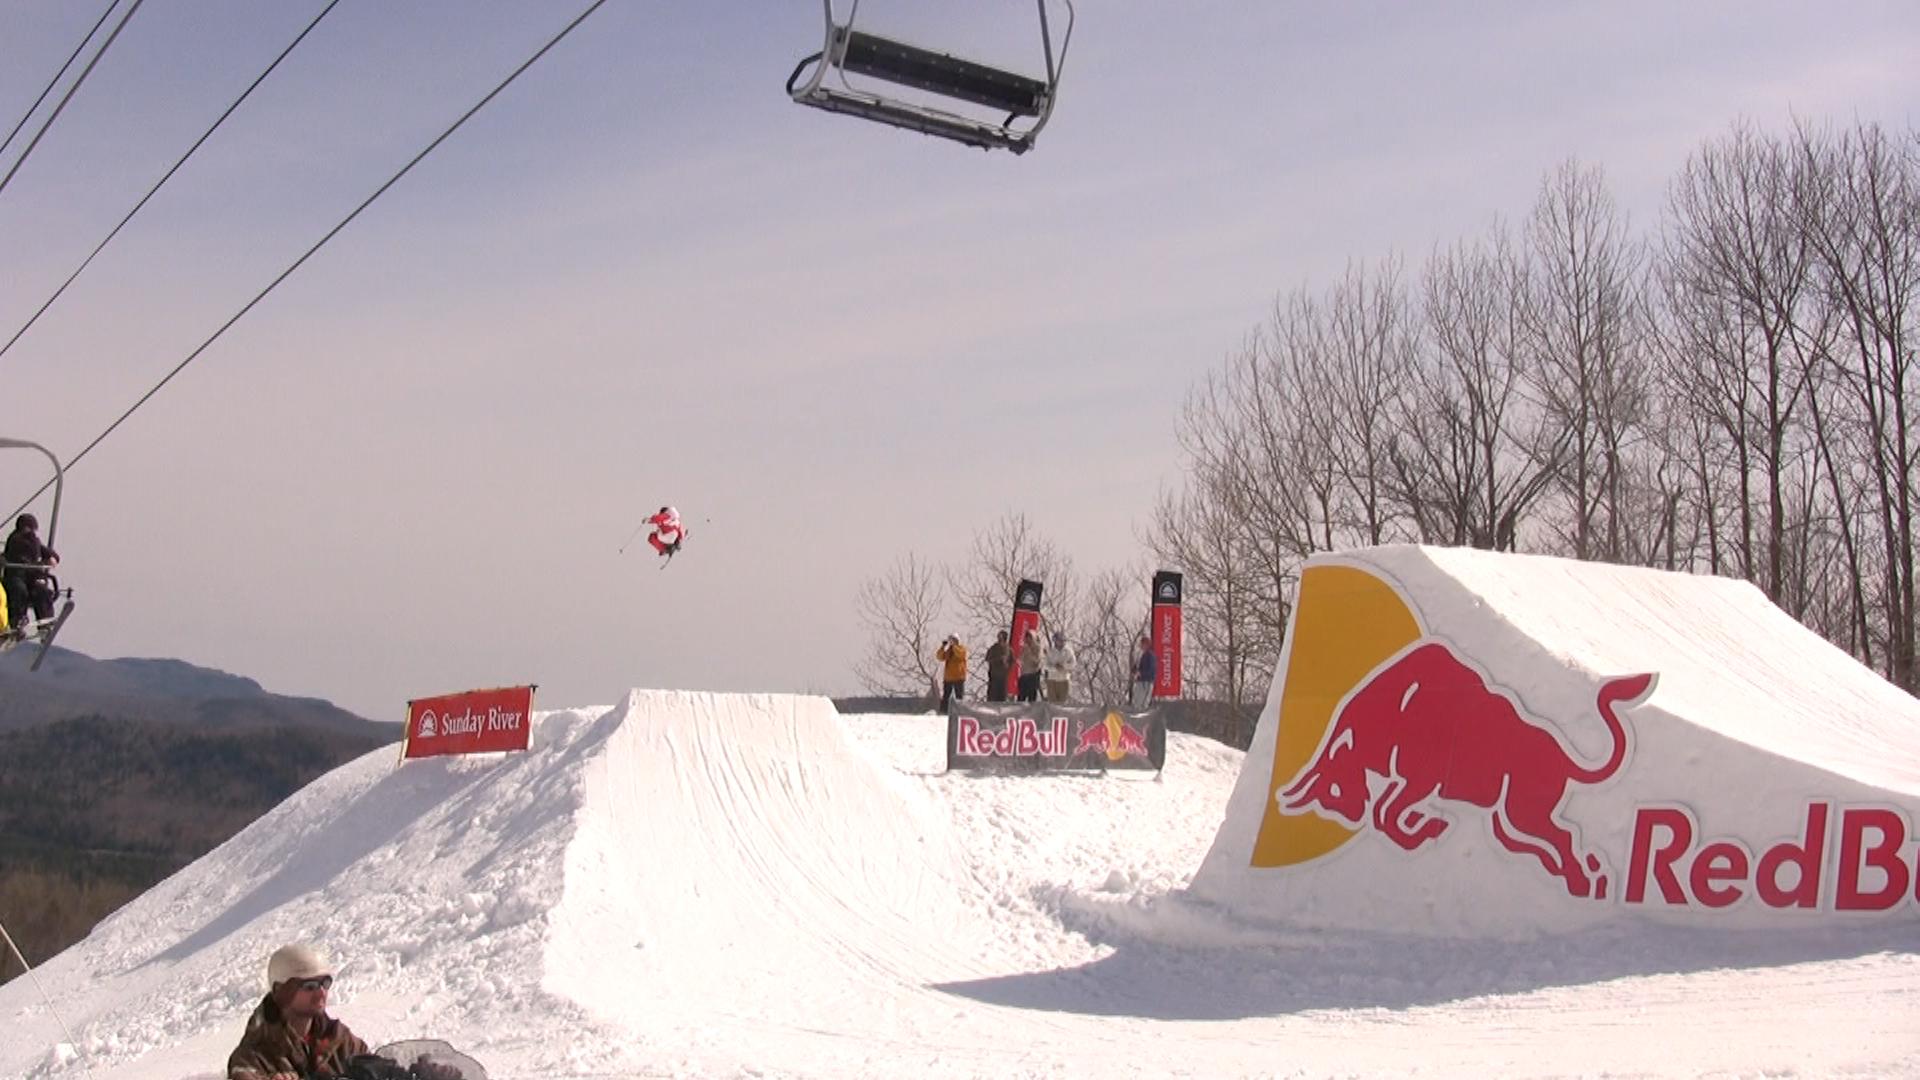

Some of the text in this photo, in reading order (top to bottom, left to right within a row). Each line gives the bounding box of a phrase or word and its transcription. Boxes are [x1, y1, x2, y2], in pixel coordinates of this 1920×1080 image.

[1161, 646, 1174, 687] Sunday
[441, 706, 522, 738] Sunday River
